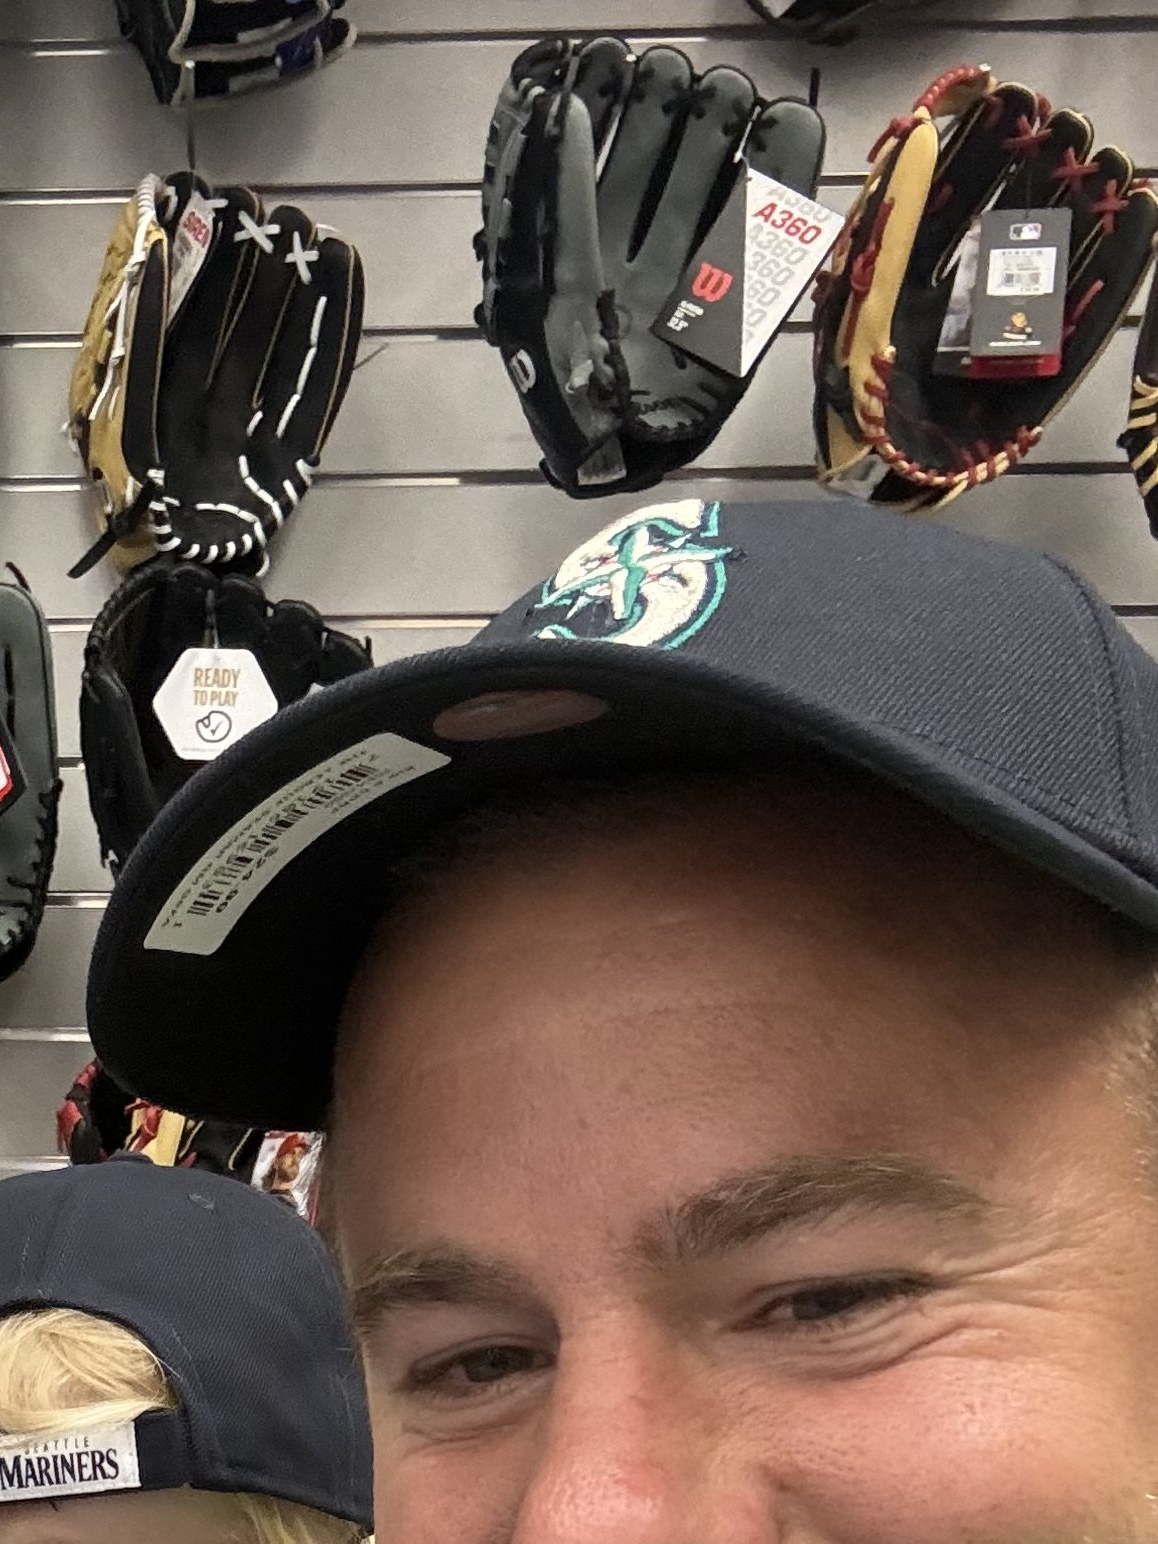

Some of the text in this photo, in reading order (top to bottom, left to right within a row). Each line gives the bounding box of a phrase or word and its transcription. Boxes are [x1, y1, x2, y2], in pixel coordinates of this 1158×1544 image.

[753, 202, 822, 244] A360
[194, 667, 240, 688] READY
[194, 690, 239, 706] TO PLAY
[24, 1435, 90, 1456] SEATTLE
